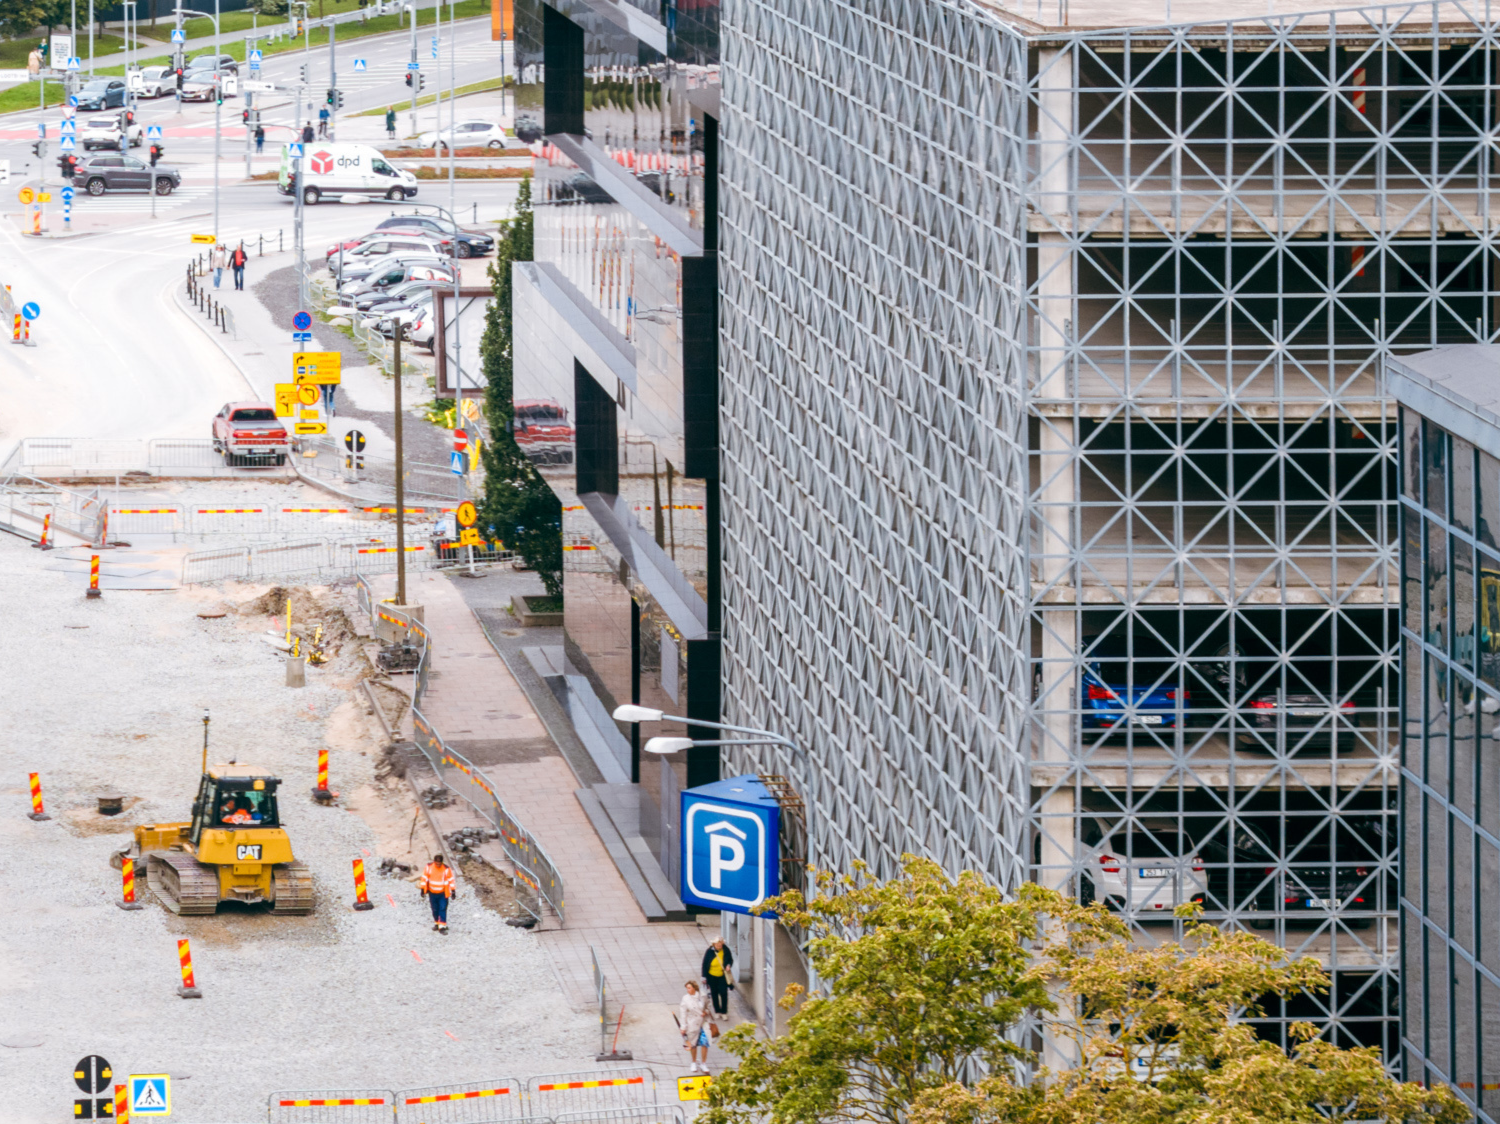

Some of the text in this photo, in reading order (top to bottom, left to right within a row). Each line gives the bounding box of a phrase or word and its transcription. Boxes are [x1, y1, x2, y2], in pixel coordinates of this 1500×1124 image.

[337, 155, 360, 168] dpd
[237, 845, 261, 860] CAT
[710, 835, 745, 889] P
